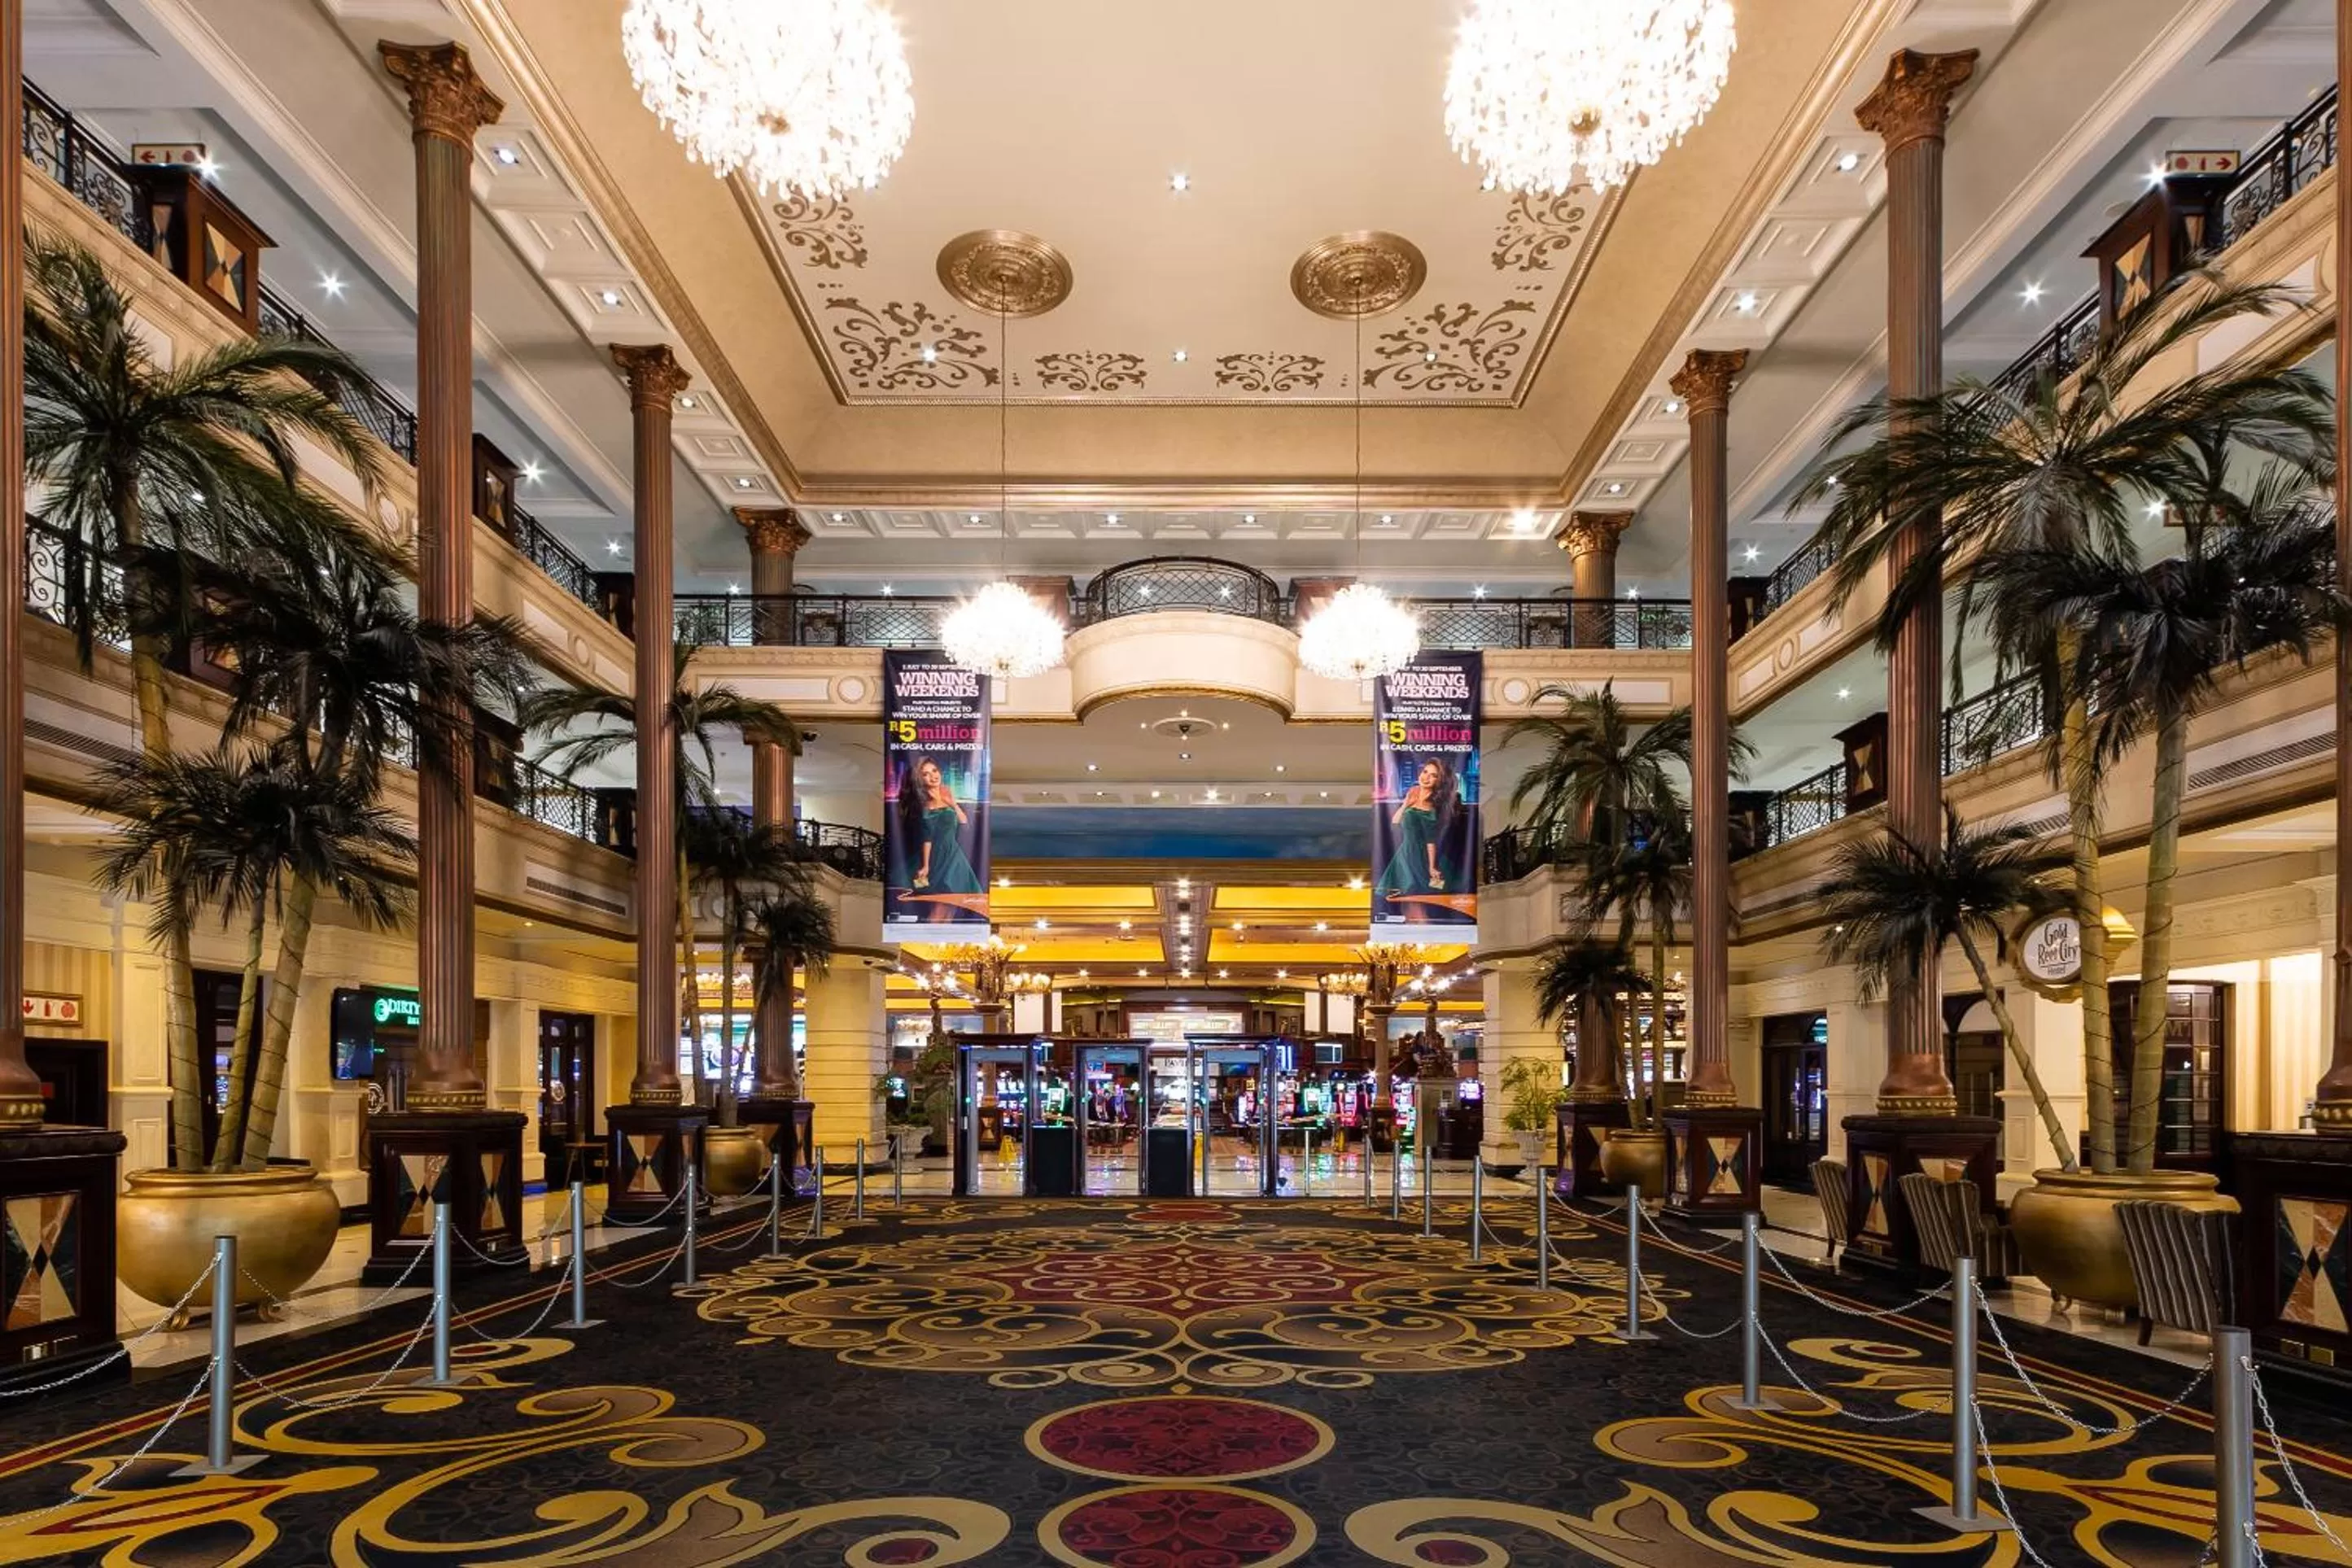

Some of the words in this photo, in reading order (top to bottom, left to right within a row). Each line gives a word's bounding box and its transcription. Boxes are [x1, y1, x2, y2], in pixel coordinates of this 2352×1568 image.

[898, 672, 976, 685] WINNING
[1390, 672, 1466, 686] WINNING
[895, 684, 979, 697] WEEKENDS
[1385, 685, 1469, 698] WEEKENDS
[917, 724, 981, 740] million
[1407, 724, 1472, 741] million
[2044, 921, 2067, 947] Gold
[2038, 943, 2058, 966] Reef
[2059, 939, 2079, 961] City
[388, 998, 421, 1015] DIRTY
